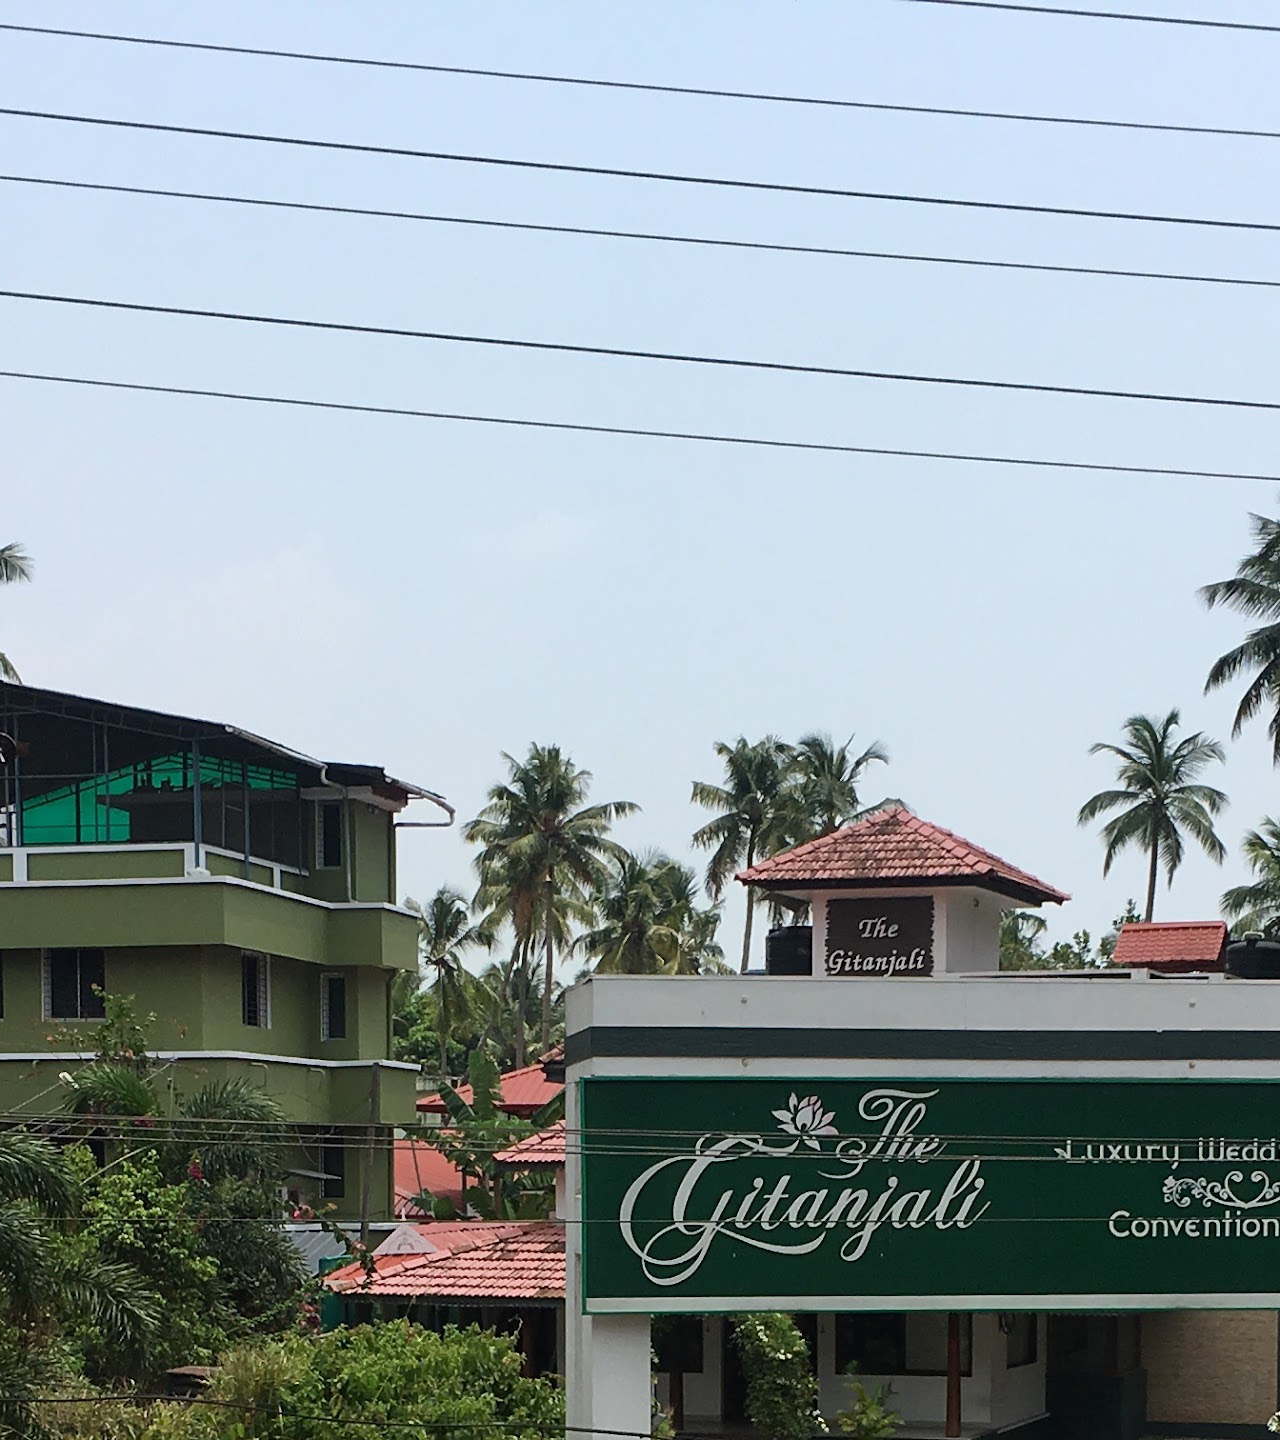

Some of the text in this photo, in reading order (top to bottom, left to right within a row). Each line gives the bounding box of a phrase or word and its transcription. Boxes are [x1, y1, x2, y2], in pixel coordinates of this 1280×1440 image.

[858, 917, 899, 939] The
[829, 948, 925, 977] Gitanjali
[819, 1089, 944, 1179] The
[1053, 1137, 1180, 1169] Luxury
[619, 1132, 992, 1287] Gitanjali
[1109, 1210, 1280, 1239] Convention
